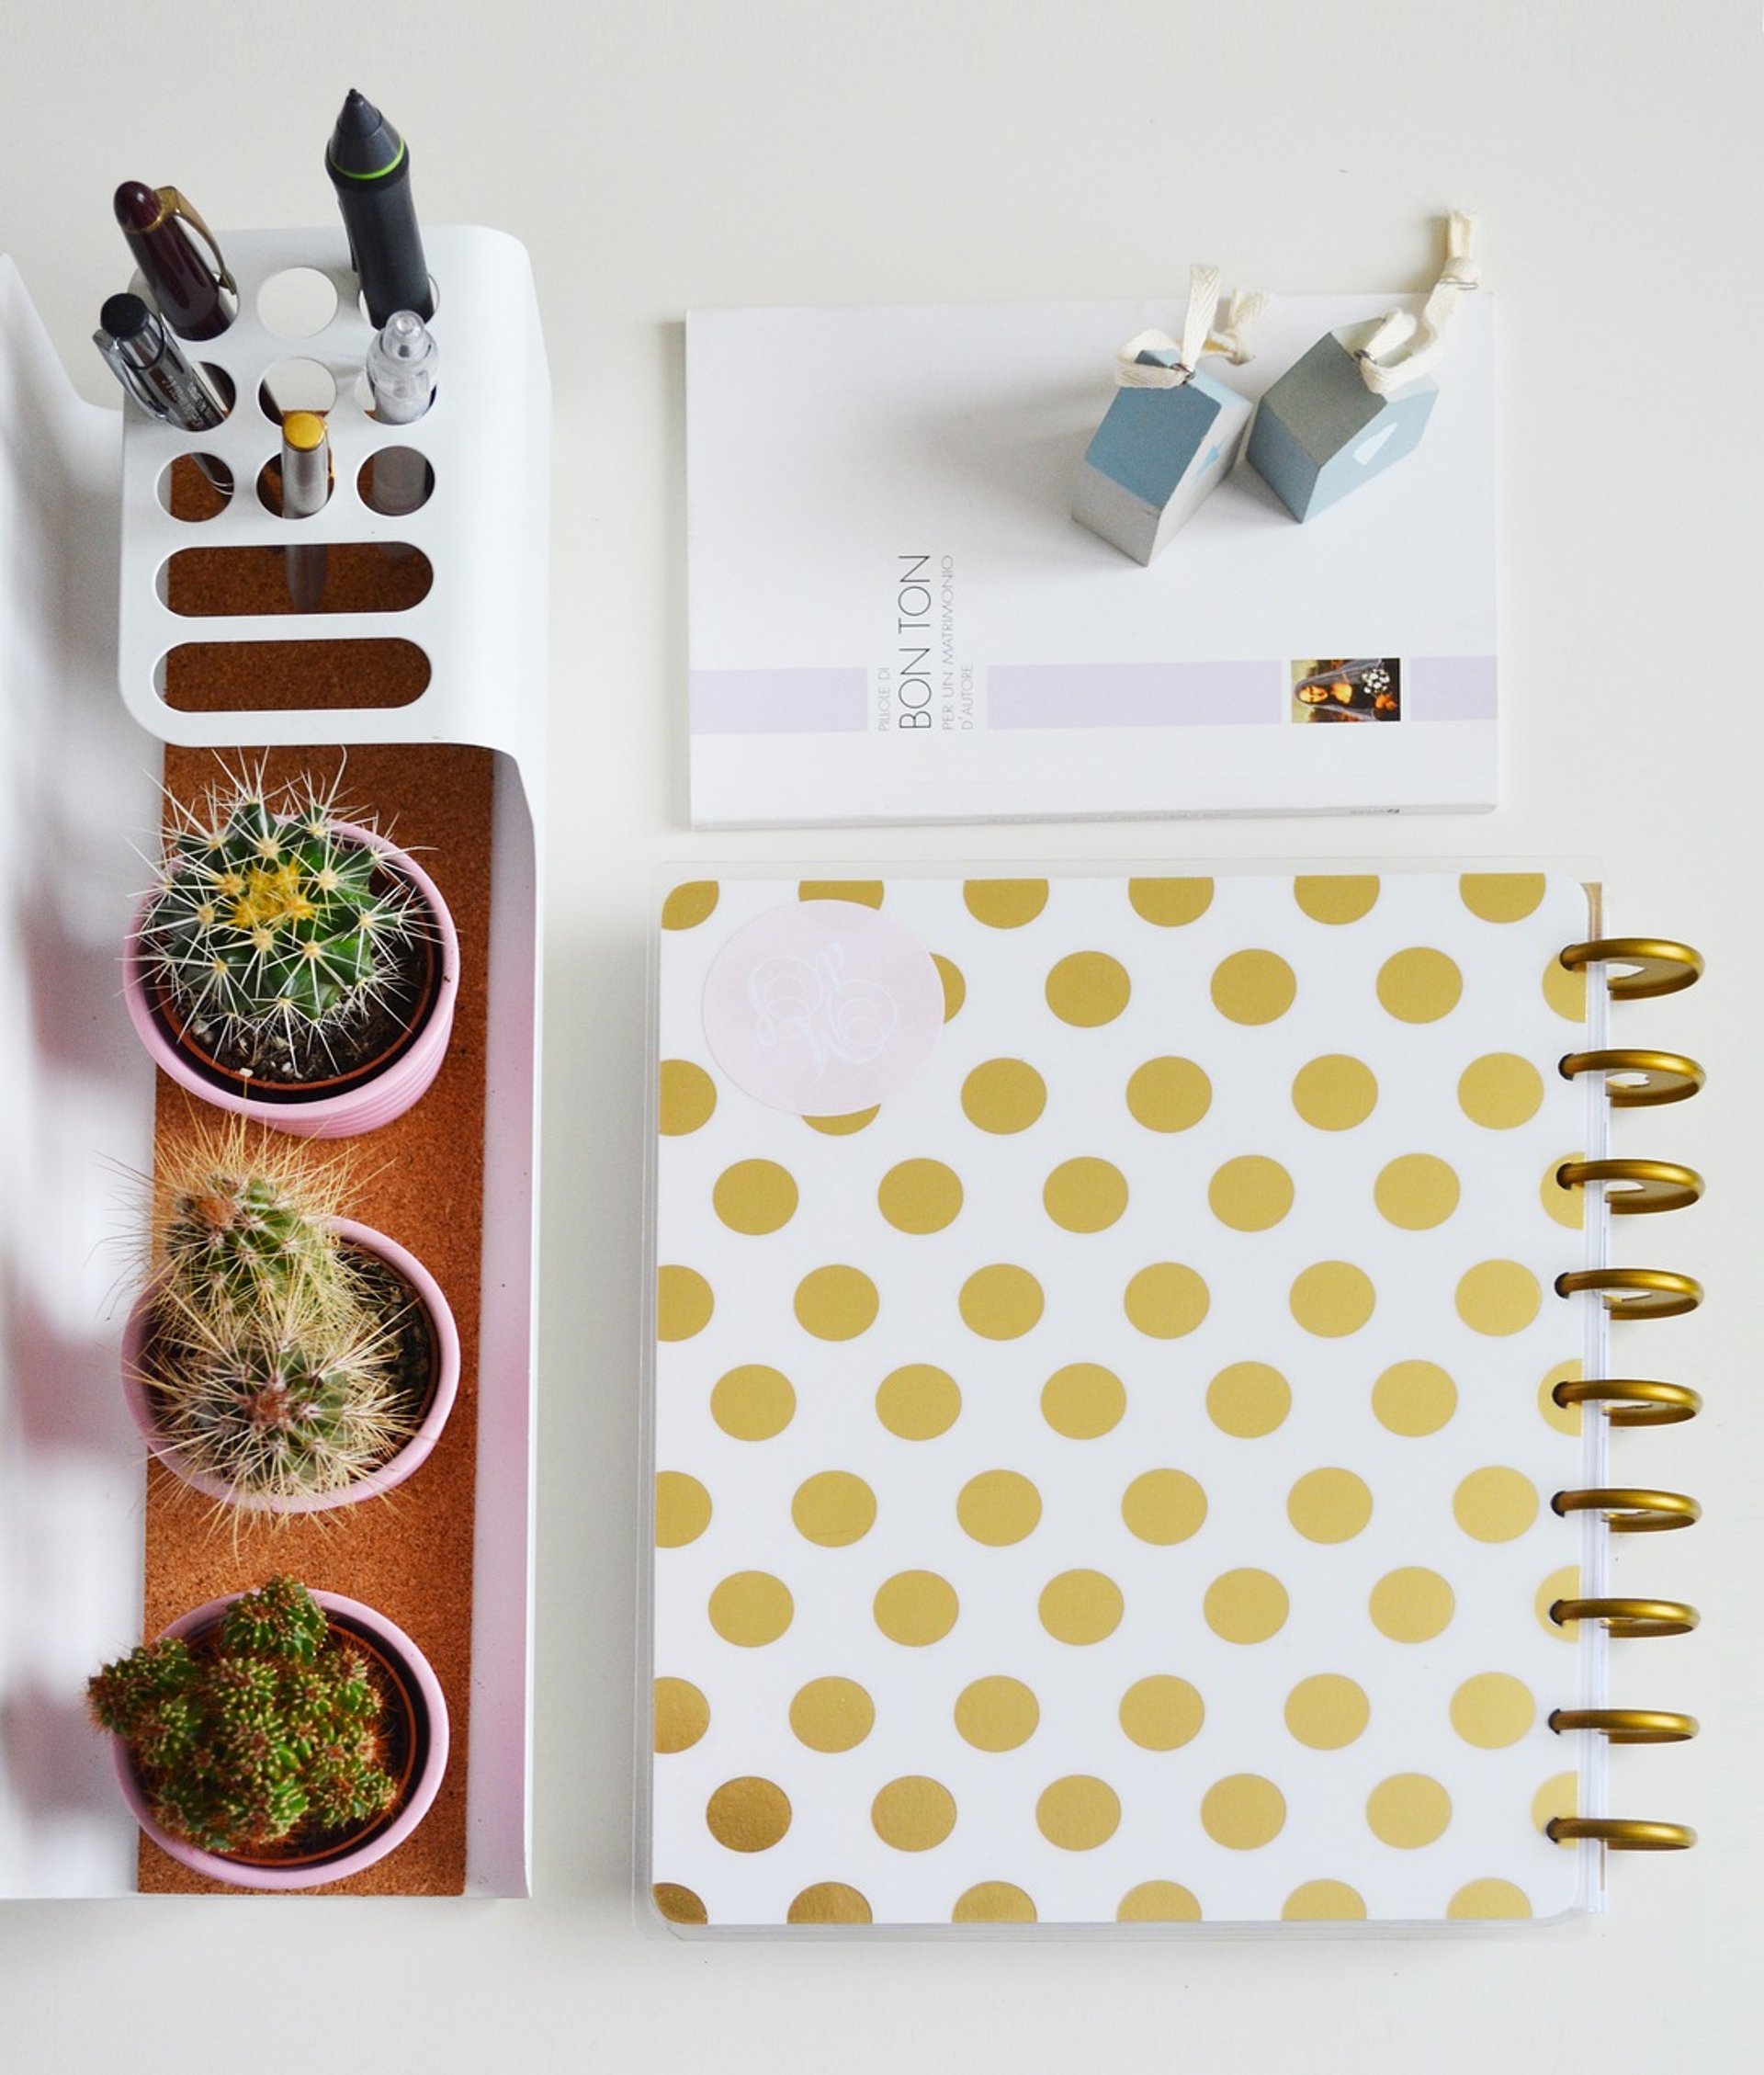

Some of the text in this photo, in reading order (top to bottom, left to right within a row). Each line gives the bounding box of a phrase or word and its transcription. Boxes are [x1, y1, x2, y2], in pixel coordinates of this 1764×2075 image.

[877, 667, 890, 680] DI
[898, 555, 932, 729] BON TON
[941, 555, 954, 731] PER UN MATRIMONIO
[959, 664, 973, 731] D'AUTORE
